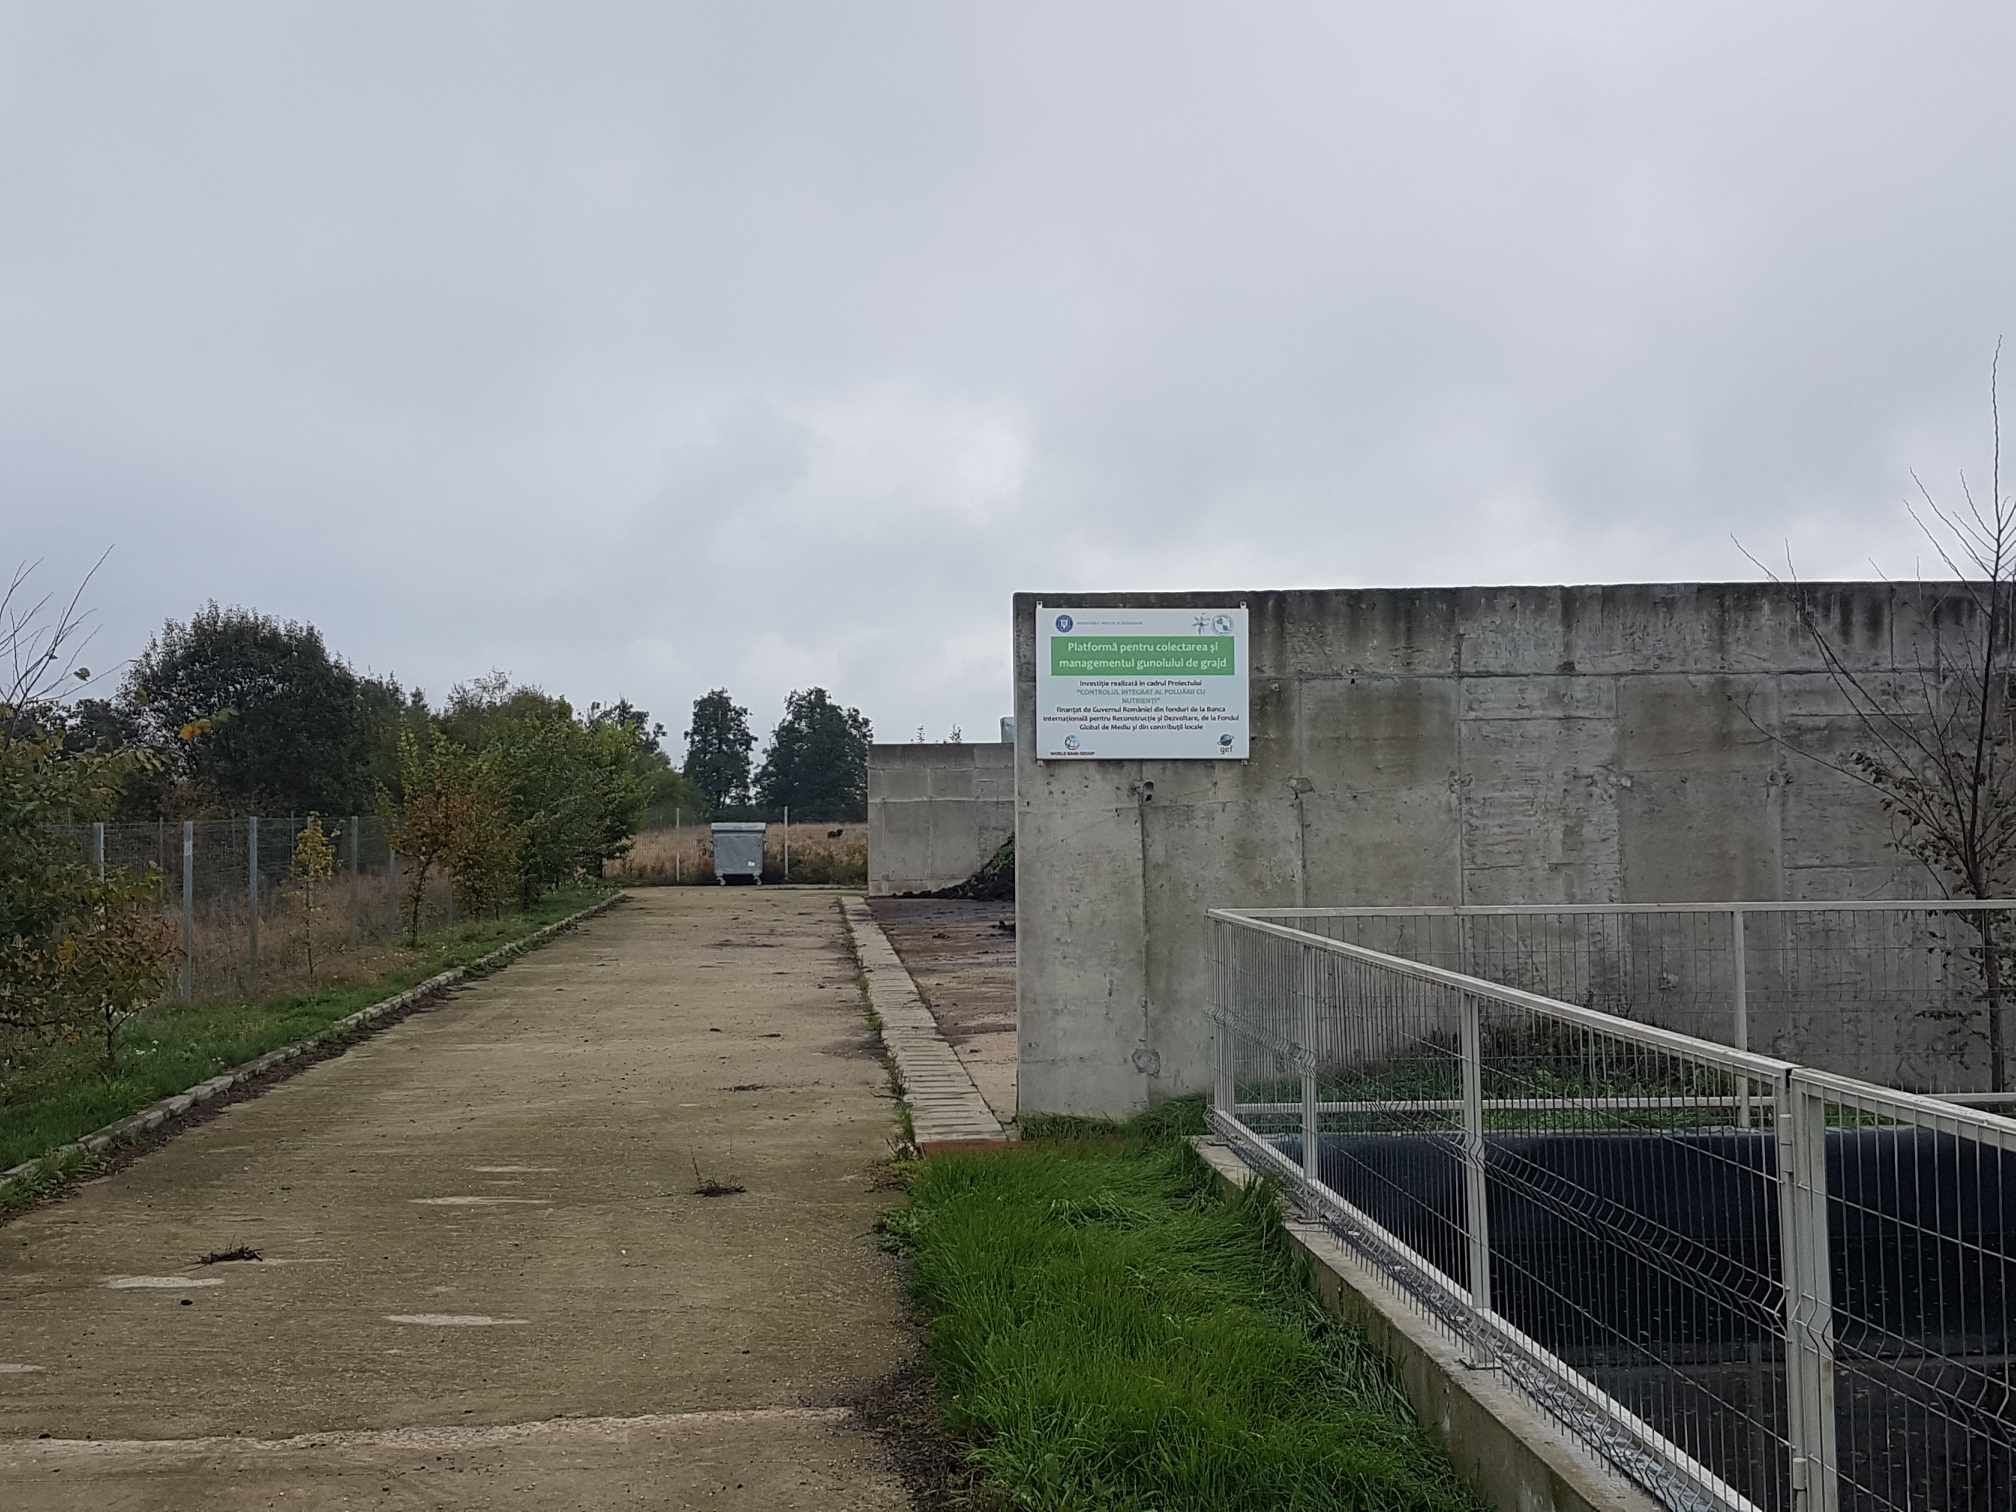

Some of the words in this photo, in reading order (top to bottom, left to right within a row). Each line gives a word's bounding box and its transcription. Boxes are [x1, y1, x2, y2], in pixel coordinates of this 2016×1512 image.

[1068, 642, 1117, 652] Platformă
[1120, 644, 1154, 655] pentru
[1156, 642, 1207, 652] colectarea
[1059, 658, 1134, 670] managementul
[1137, 658, 1184, 670] gunoiului
[1186, 658, 1198, 667] de
[1201, 657, 1227, 670] grajd
